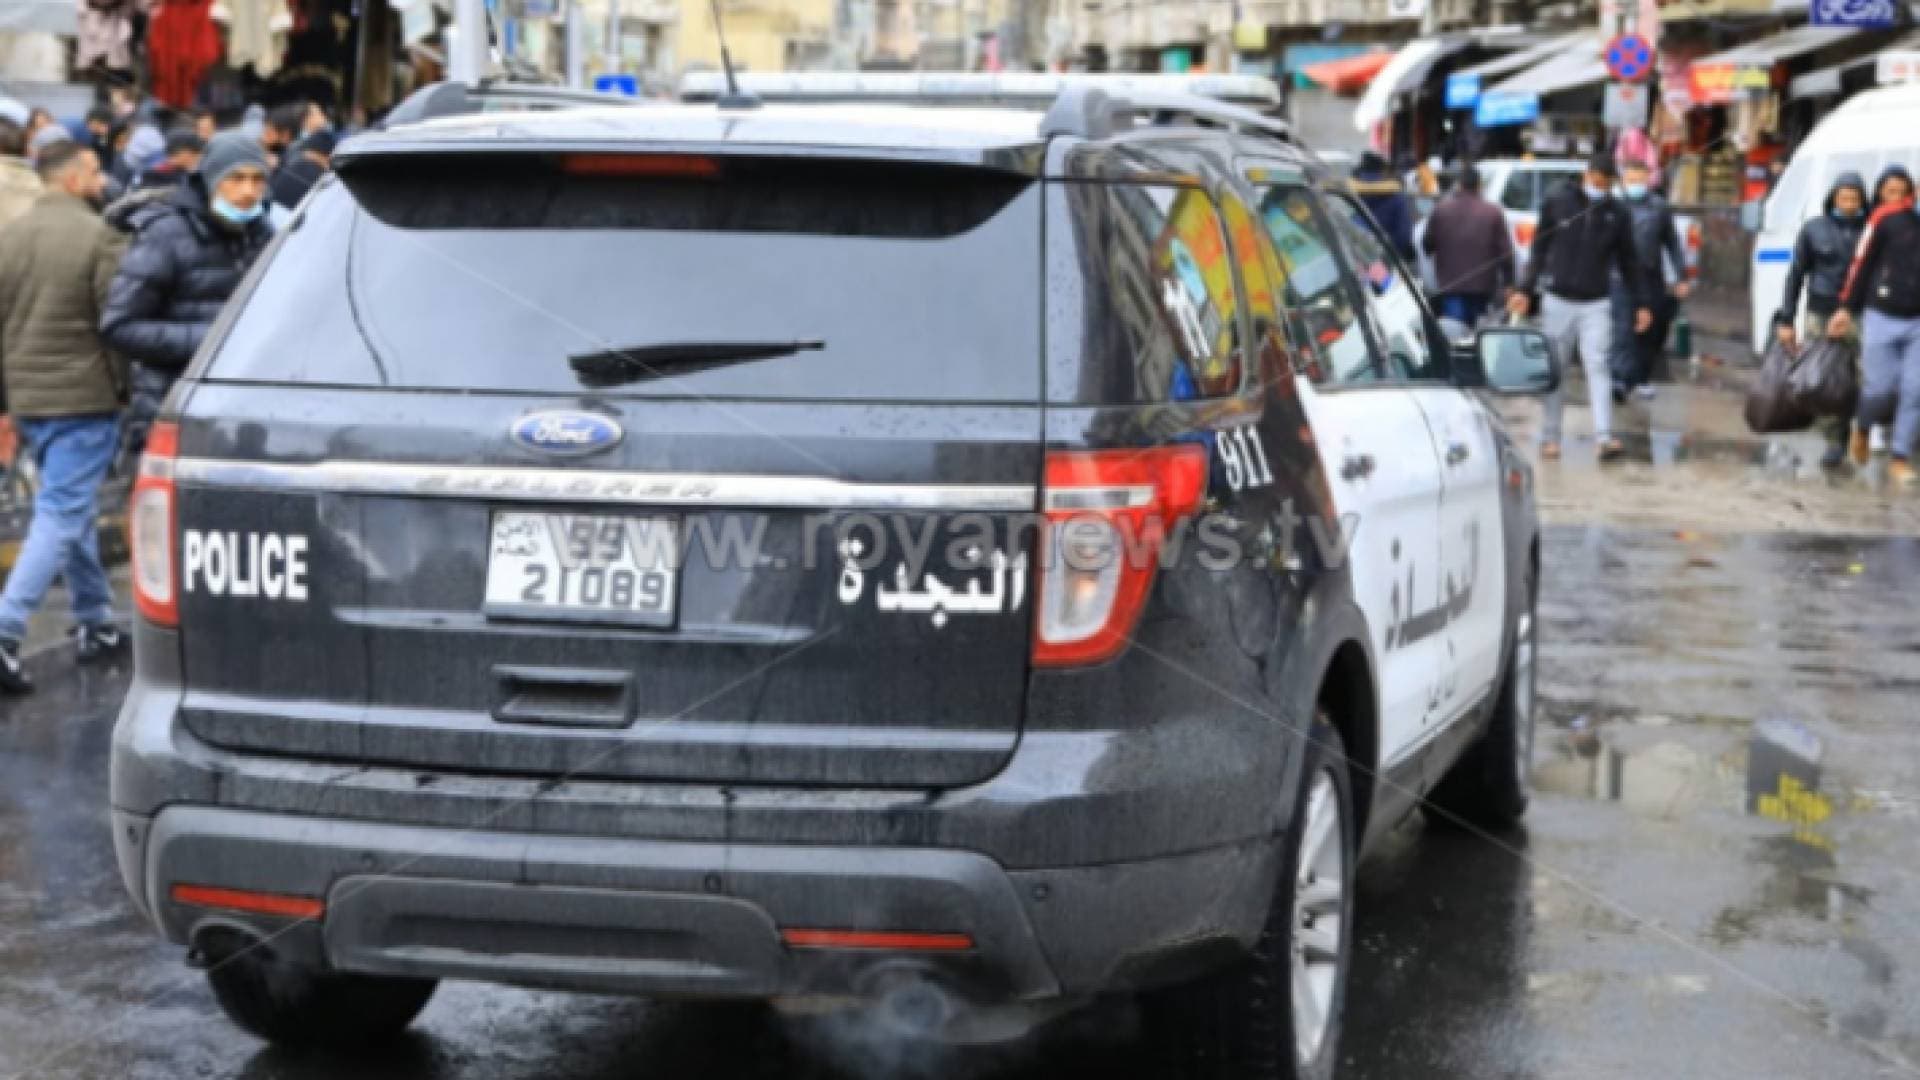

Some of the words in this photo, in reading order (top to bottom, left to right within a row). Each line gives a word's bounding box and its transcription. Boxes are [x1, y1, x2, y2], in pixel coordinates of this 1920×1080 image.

[532, 417, 594, 445] Ford
[1217, 424, 1274, 491] 911
[184, 529, 309, 600] POLICE
[521, 564, 665, 608] 21089
[838, 539, 1027, 629] النجدة
